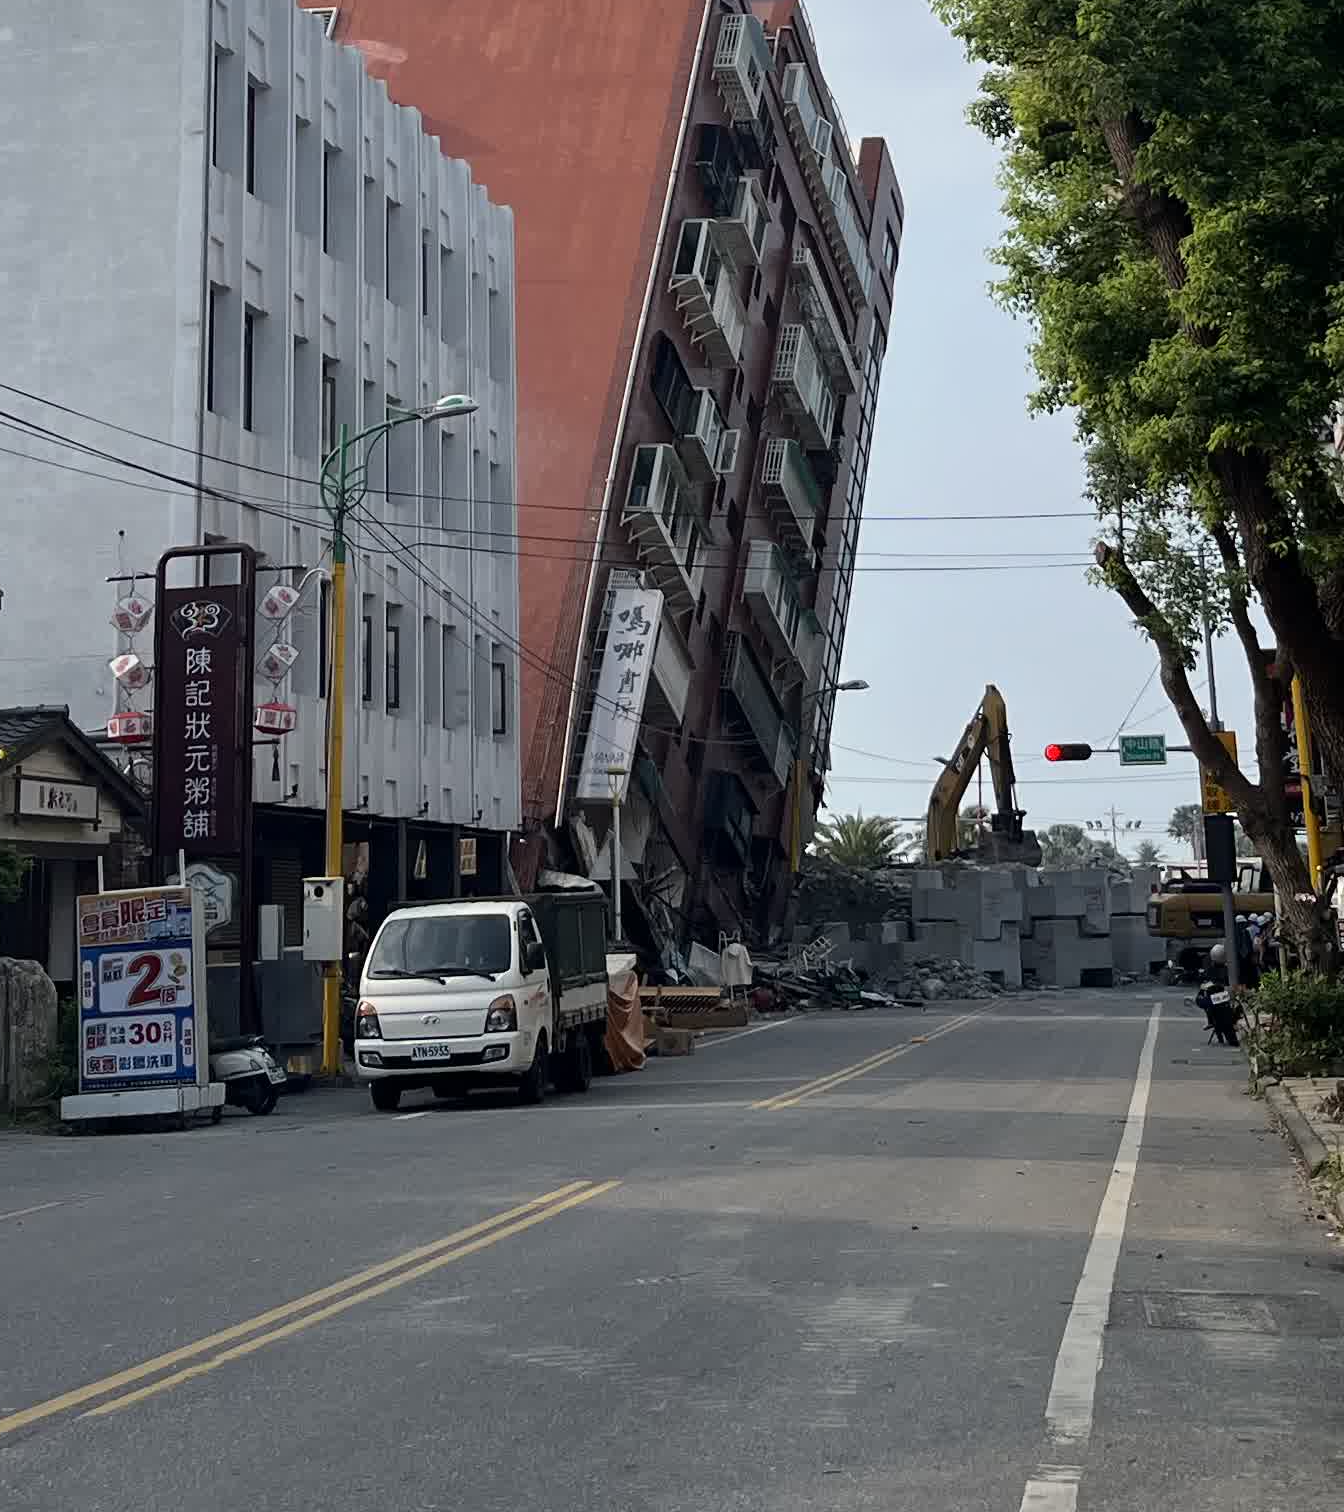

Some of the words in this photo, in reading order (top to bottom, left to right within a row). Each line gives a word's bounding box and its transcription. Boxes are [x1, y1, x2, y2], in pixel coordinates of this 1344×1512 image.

[183, 645, 212, 839] 陳記狀元粥舖
[126, 951, 165, 1008] 2
[128, 1021, 162, 1046] 30
